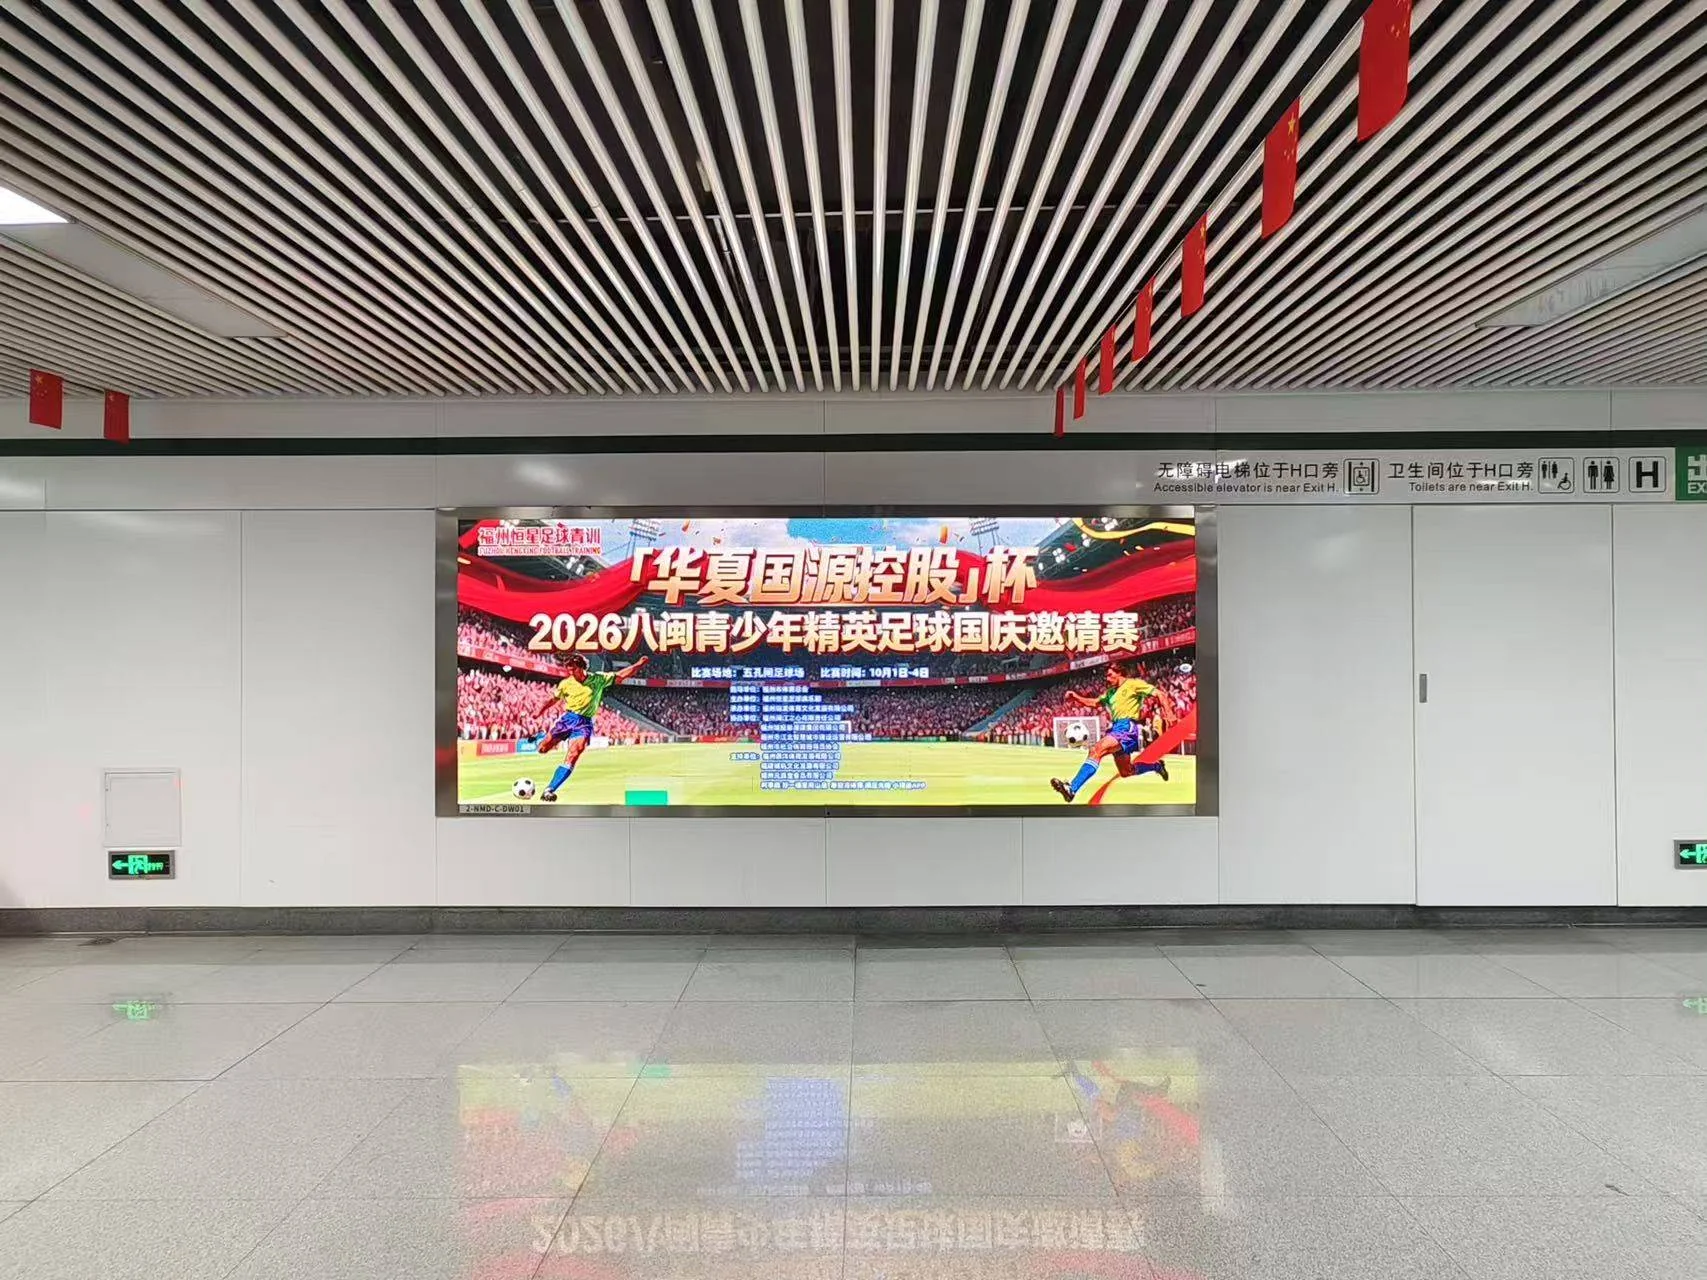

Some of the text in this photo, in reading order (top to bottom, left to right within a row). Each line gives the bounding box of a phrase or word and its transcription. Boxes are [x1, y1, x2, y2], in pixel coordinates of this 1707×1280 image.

[1158, 462, 1339, 479] 无障碍电梯位于H口旁
[1388, 462, 1534, 479] 卫生间位于H口旁
[1636, 461, 1659, 488] H
[1153, 482, 1214, 493] Accessible
[1216, 482, 1261, 493] elevator
[1264, 482, 1273, 493] is
[1275, 484, 1301, 493] near
[1303, 482, 1324, 493] Exit
[1409, 481, 1445, 492] Toilets
[1448, 483, 1466, 492] are
[1469, 483, 1495, 492] near
[1497, 481, 1520, 492] Exit
[1687, 482, 1707, 494] EX
[478, 526, 601, 545] 福州恒星足球青训
[528, 610, 1139, 654] 2026八闽青少年精英足球国庆邀请赛
